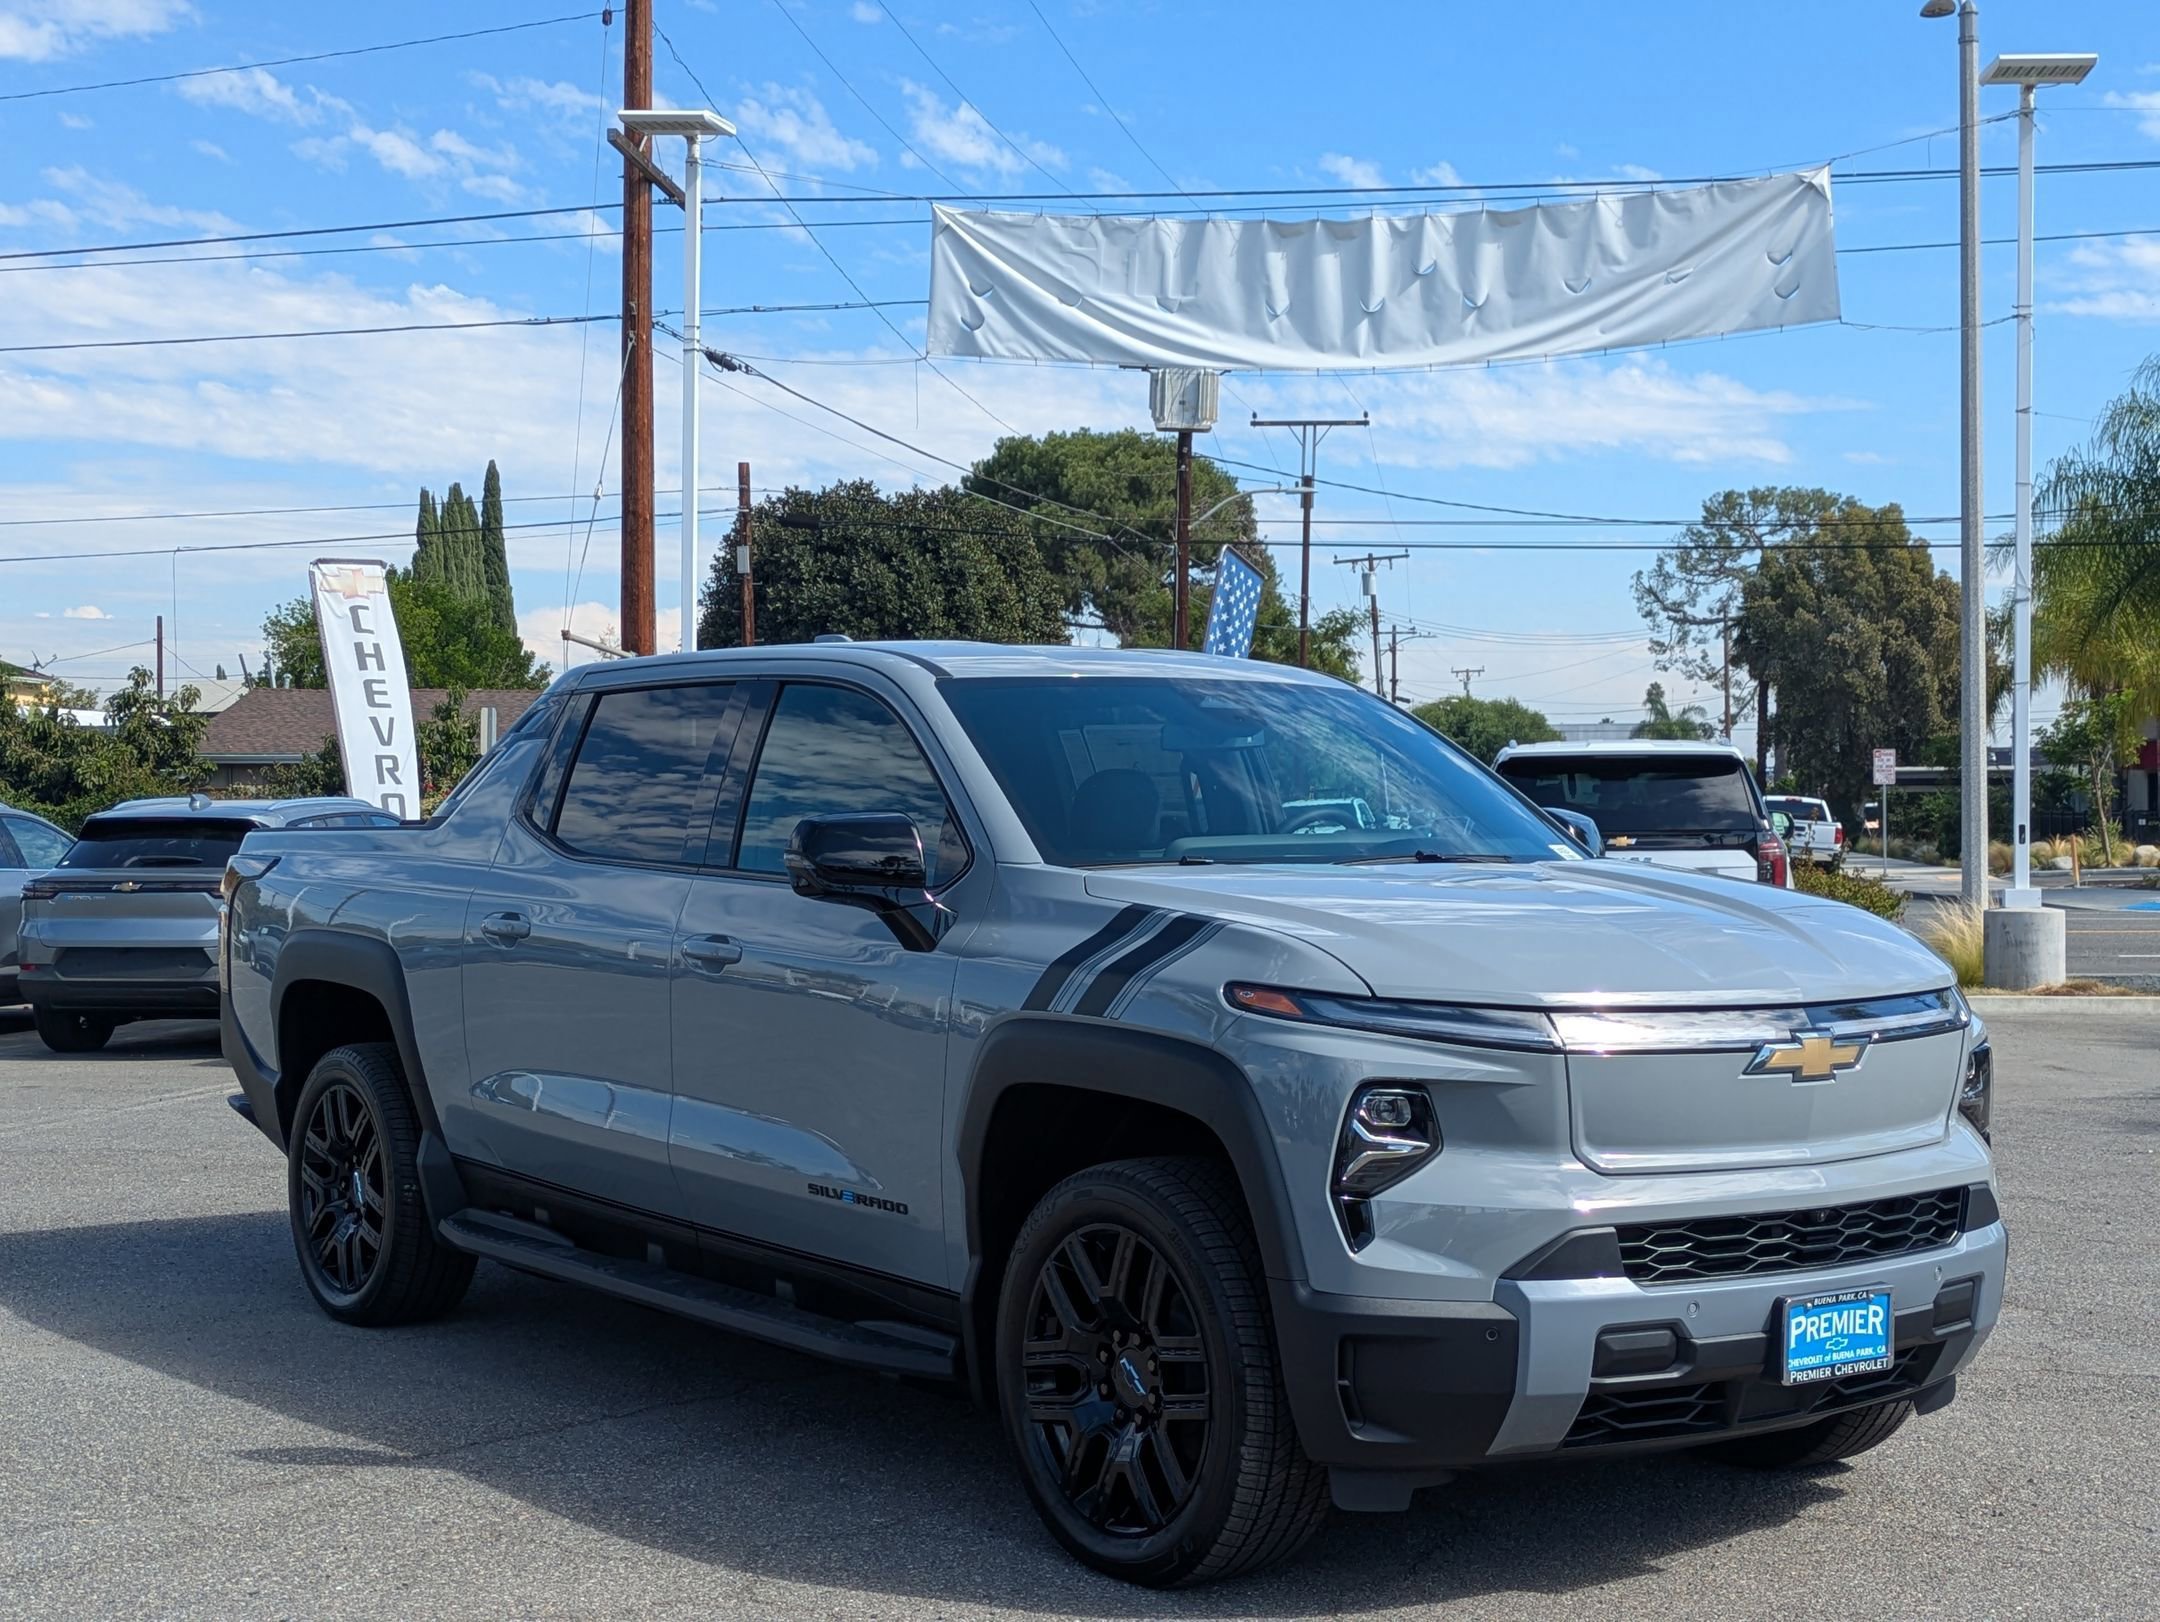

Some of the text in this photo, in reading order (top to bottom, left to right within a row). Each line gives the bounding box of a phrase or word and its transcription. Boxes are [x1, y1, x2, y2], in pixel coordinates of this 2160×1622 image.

[807, 1182, 909, 1216] SILVERADO
[1813, 1297, 1837, 1306] BUENA
[1790, 1304, 1884, 1350] PREMIER
[1788, 1355, 1823, 1369] CHEVROLET
[1824, 1354, 1831, 1362] of
[1832, 1350, 1855, 1360] BUENA
[1877, 1345, 1886, 1354] CA
[1790, 1357, 1889, 1383] PREMIER CHEVROLET
